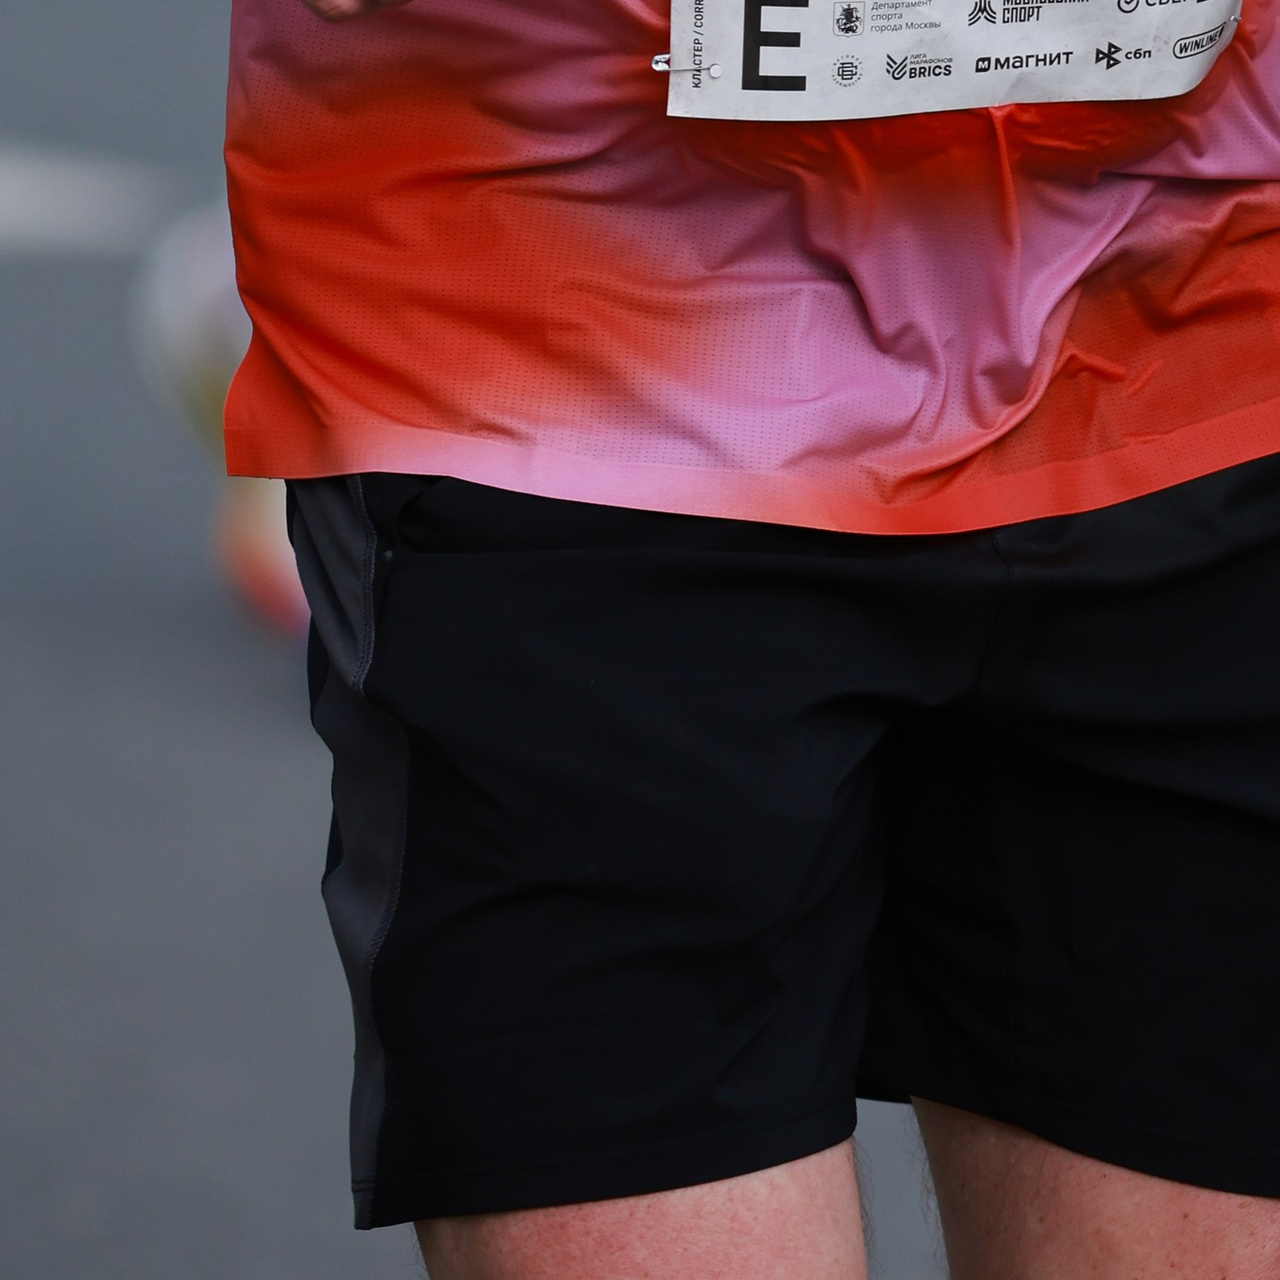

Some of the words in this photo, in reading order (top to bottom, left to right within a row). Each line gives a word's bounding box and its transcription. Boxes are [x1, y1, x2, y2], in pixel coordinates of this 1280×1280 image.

[871, 0, 933, 11] Департамент
[871, 13, 903, 22] спорта
[1002, 6, 1042, 24] СПОРТ
[871, 23, 903, 34] города
[905, 21, 941, 30] Москвы
[1179, 30, 1220, 55] WINLINE
[908, 64, 952, 79] BRICS
